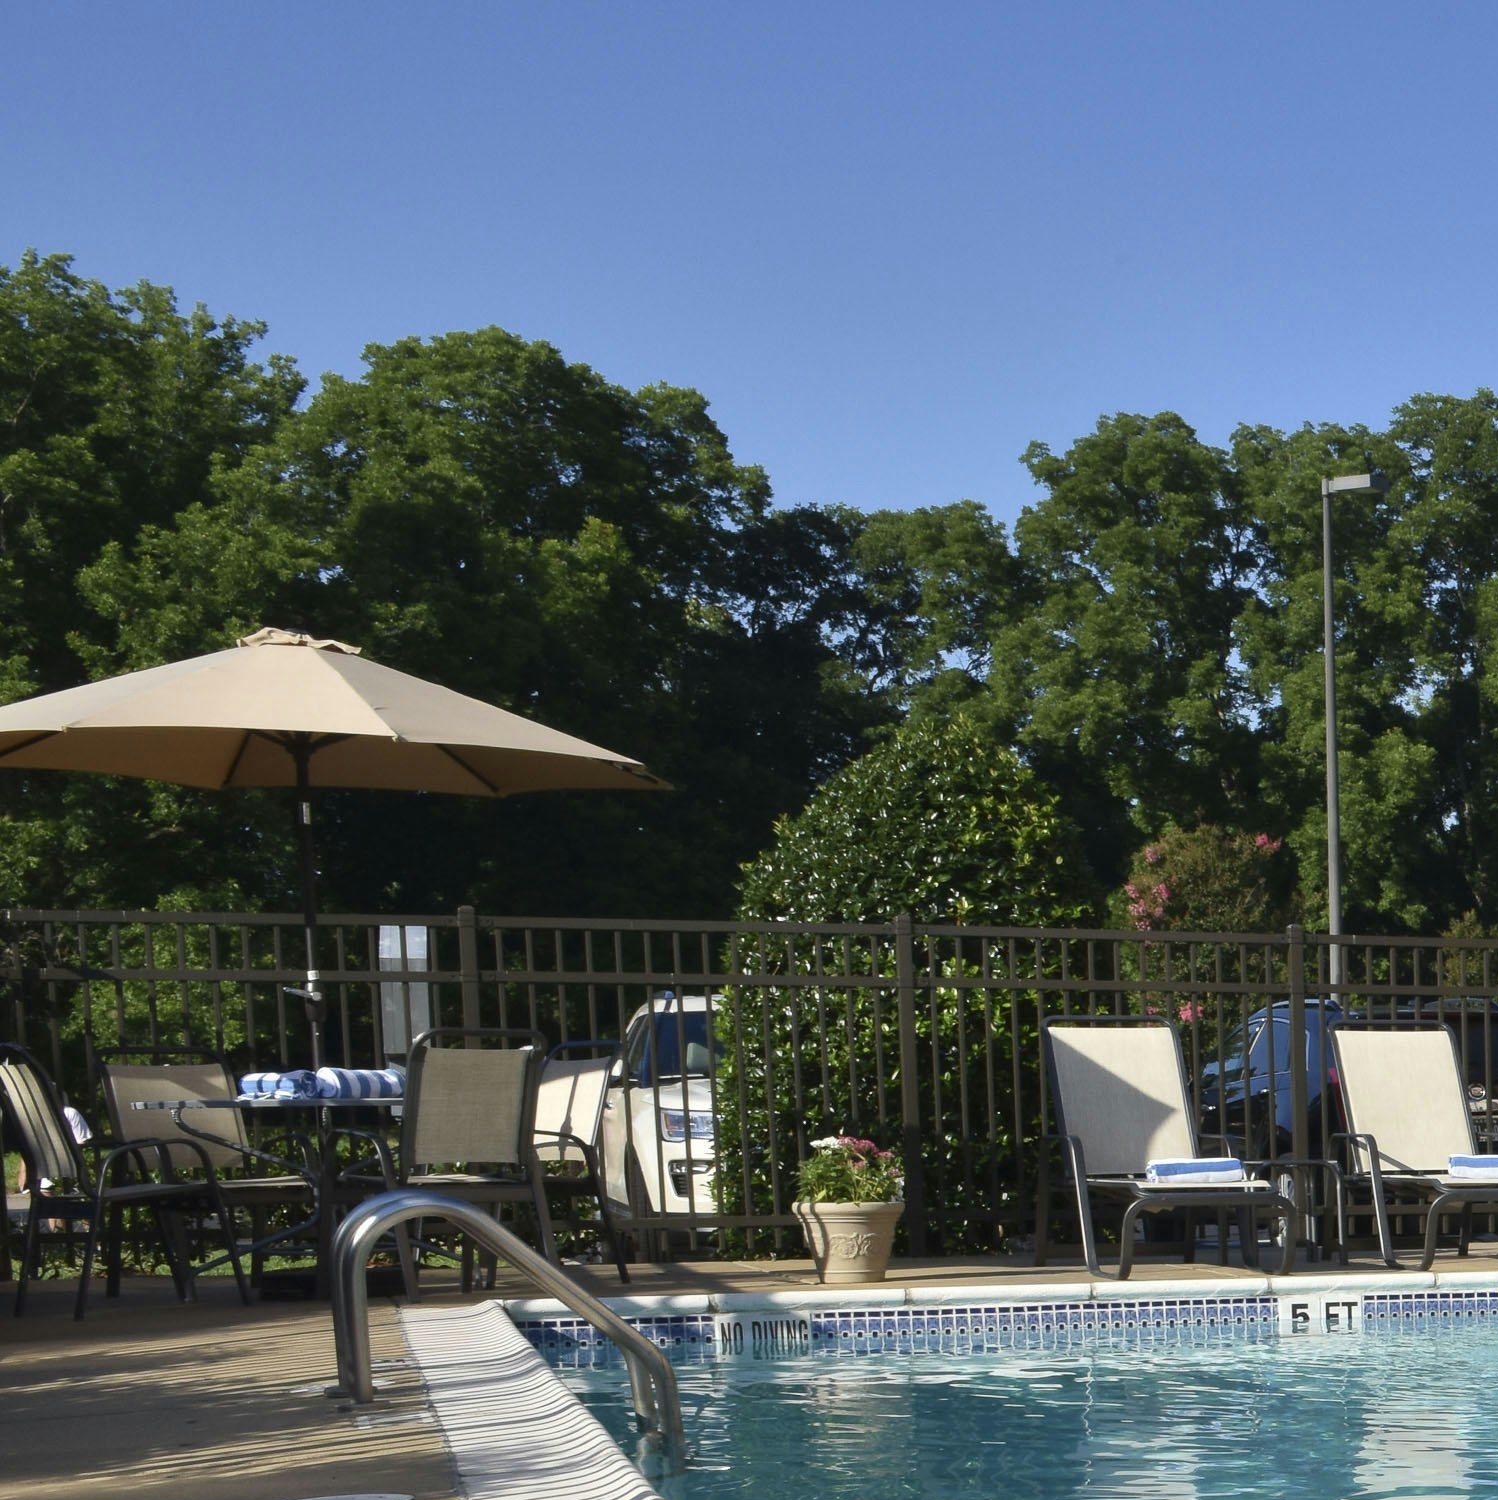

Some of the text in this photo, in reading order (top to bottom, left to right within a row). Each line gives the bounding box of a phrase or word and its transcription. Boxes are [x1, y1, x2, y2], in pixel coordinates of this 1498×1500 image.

[1291, 1302, 1358, 1325] 5 FT
[720, 1319, 808, 1346] NO DIVING
